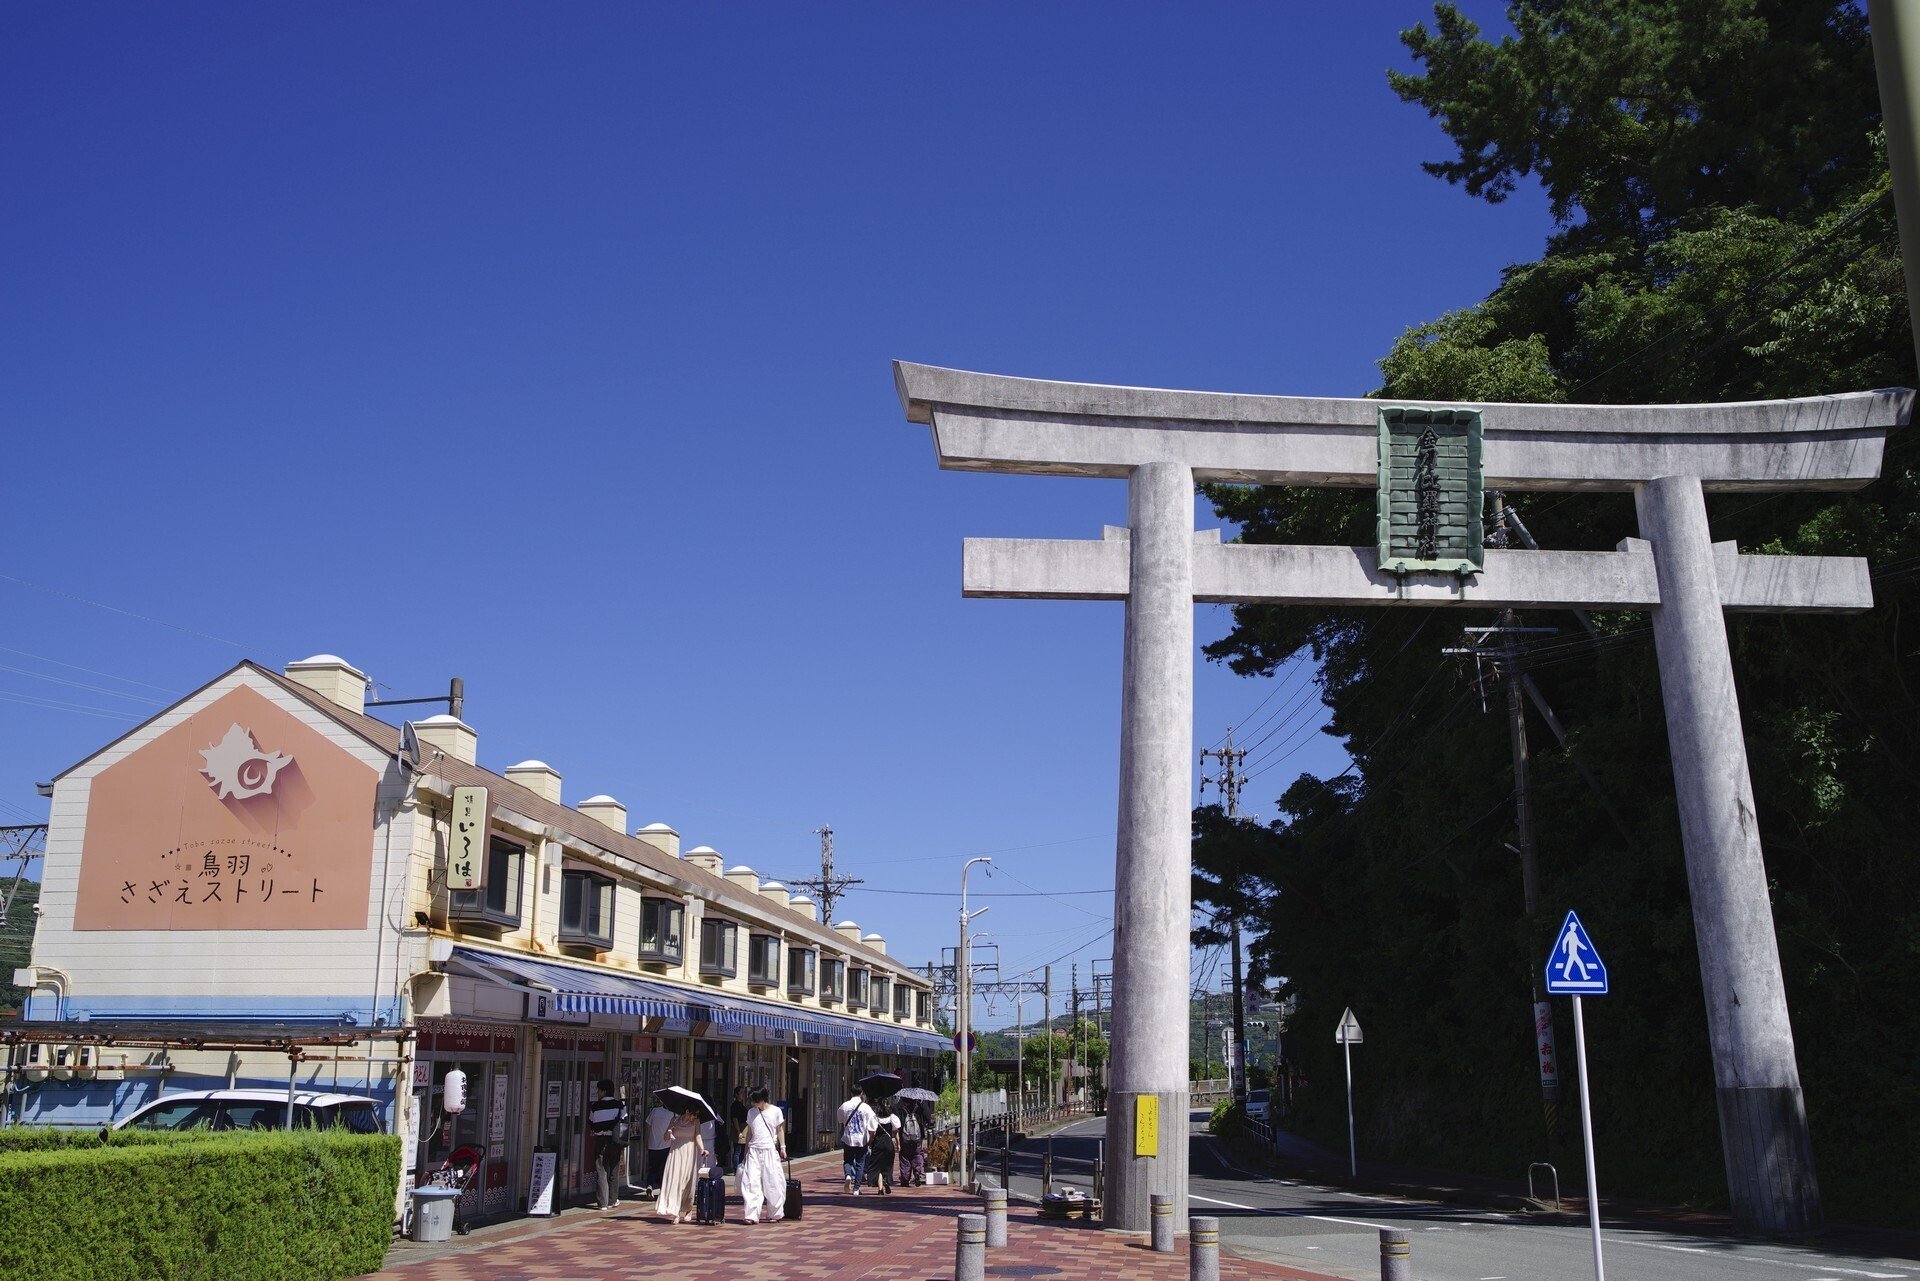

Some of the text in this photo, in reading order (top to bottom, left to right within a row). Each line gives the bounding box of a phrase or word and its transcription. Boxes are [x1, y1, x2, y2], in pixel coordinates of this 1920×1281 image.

[184, 841, 205, 850] Toba
[241, 838, 271, 850] street
[454, 821, 475, 877] いろは
[198, 850, 250, 878] 鳥羽
[120, 878, 324, 904] さざえストリート
[414, 1065, 429, 1083] うどん
